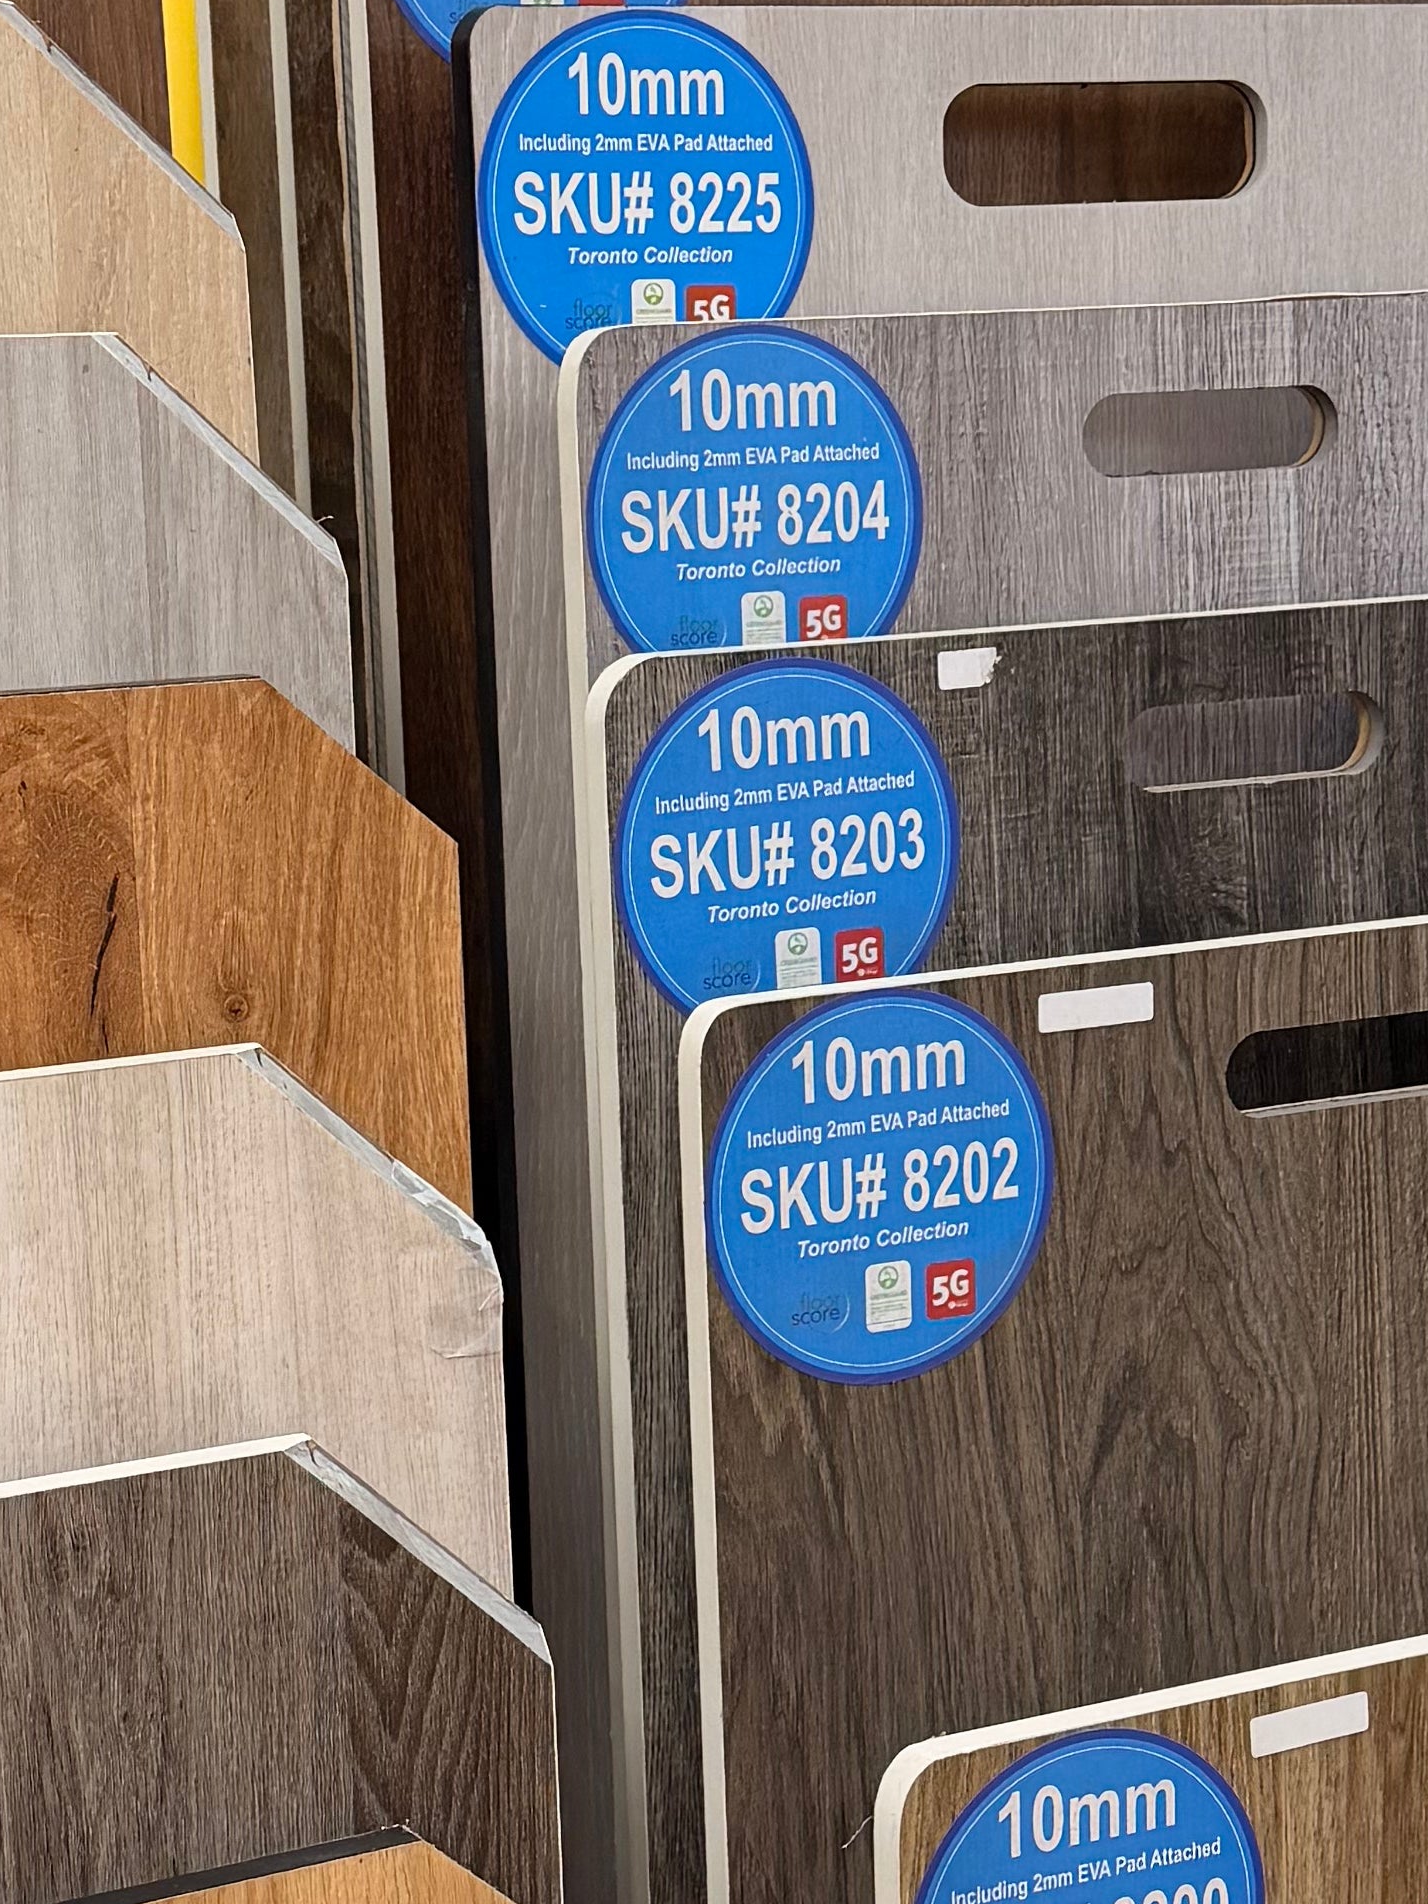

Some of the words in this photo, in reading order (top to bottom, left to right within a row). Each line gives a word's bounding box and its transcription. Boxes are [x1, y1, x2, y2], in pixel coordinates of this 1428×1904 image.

[568, 51, 725, 116] 10mm
[513, 171, 654, 236] SKU#
[669, 171, 782, 234] 8225
[693, 294, 731, 321] 5G
[669, 368, 837, 432] 10mm
[621, 484, 762, 554] SKU#
[777, 479, 890, 546] 8204
[806, 604, 842, 639] 5G
[698, 705, 870, 772] 10mm
[650, 820, 795, 899] SKU#
[810, 807, 925, 880] 8203
[842, 936, 878, 973] 5G
[792, 1036, 965, 1105] 10mm
[747, 1125, 822, 1149] Including
[826, 1120, 866, 1139] 2mm
[870, 1112, 904, 1133] EVA
[907, 1108, 937, 1128] Pad
[940, 1098, 1010, 1124] Attached
[740, 1152, 887, 1235] SKU#
[903, 1137, 1019, 1212] 8202
[797, 1234, 870, 1258] Toronto
[876, 1221, 969, 1247] Collection
[932, 1268, 969, 1307] 5G
[998, 1779, 1176, 1859] 10mm
